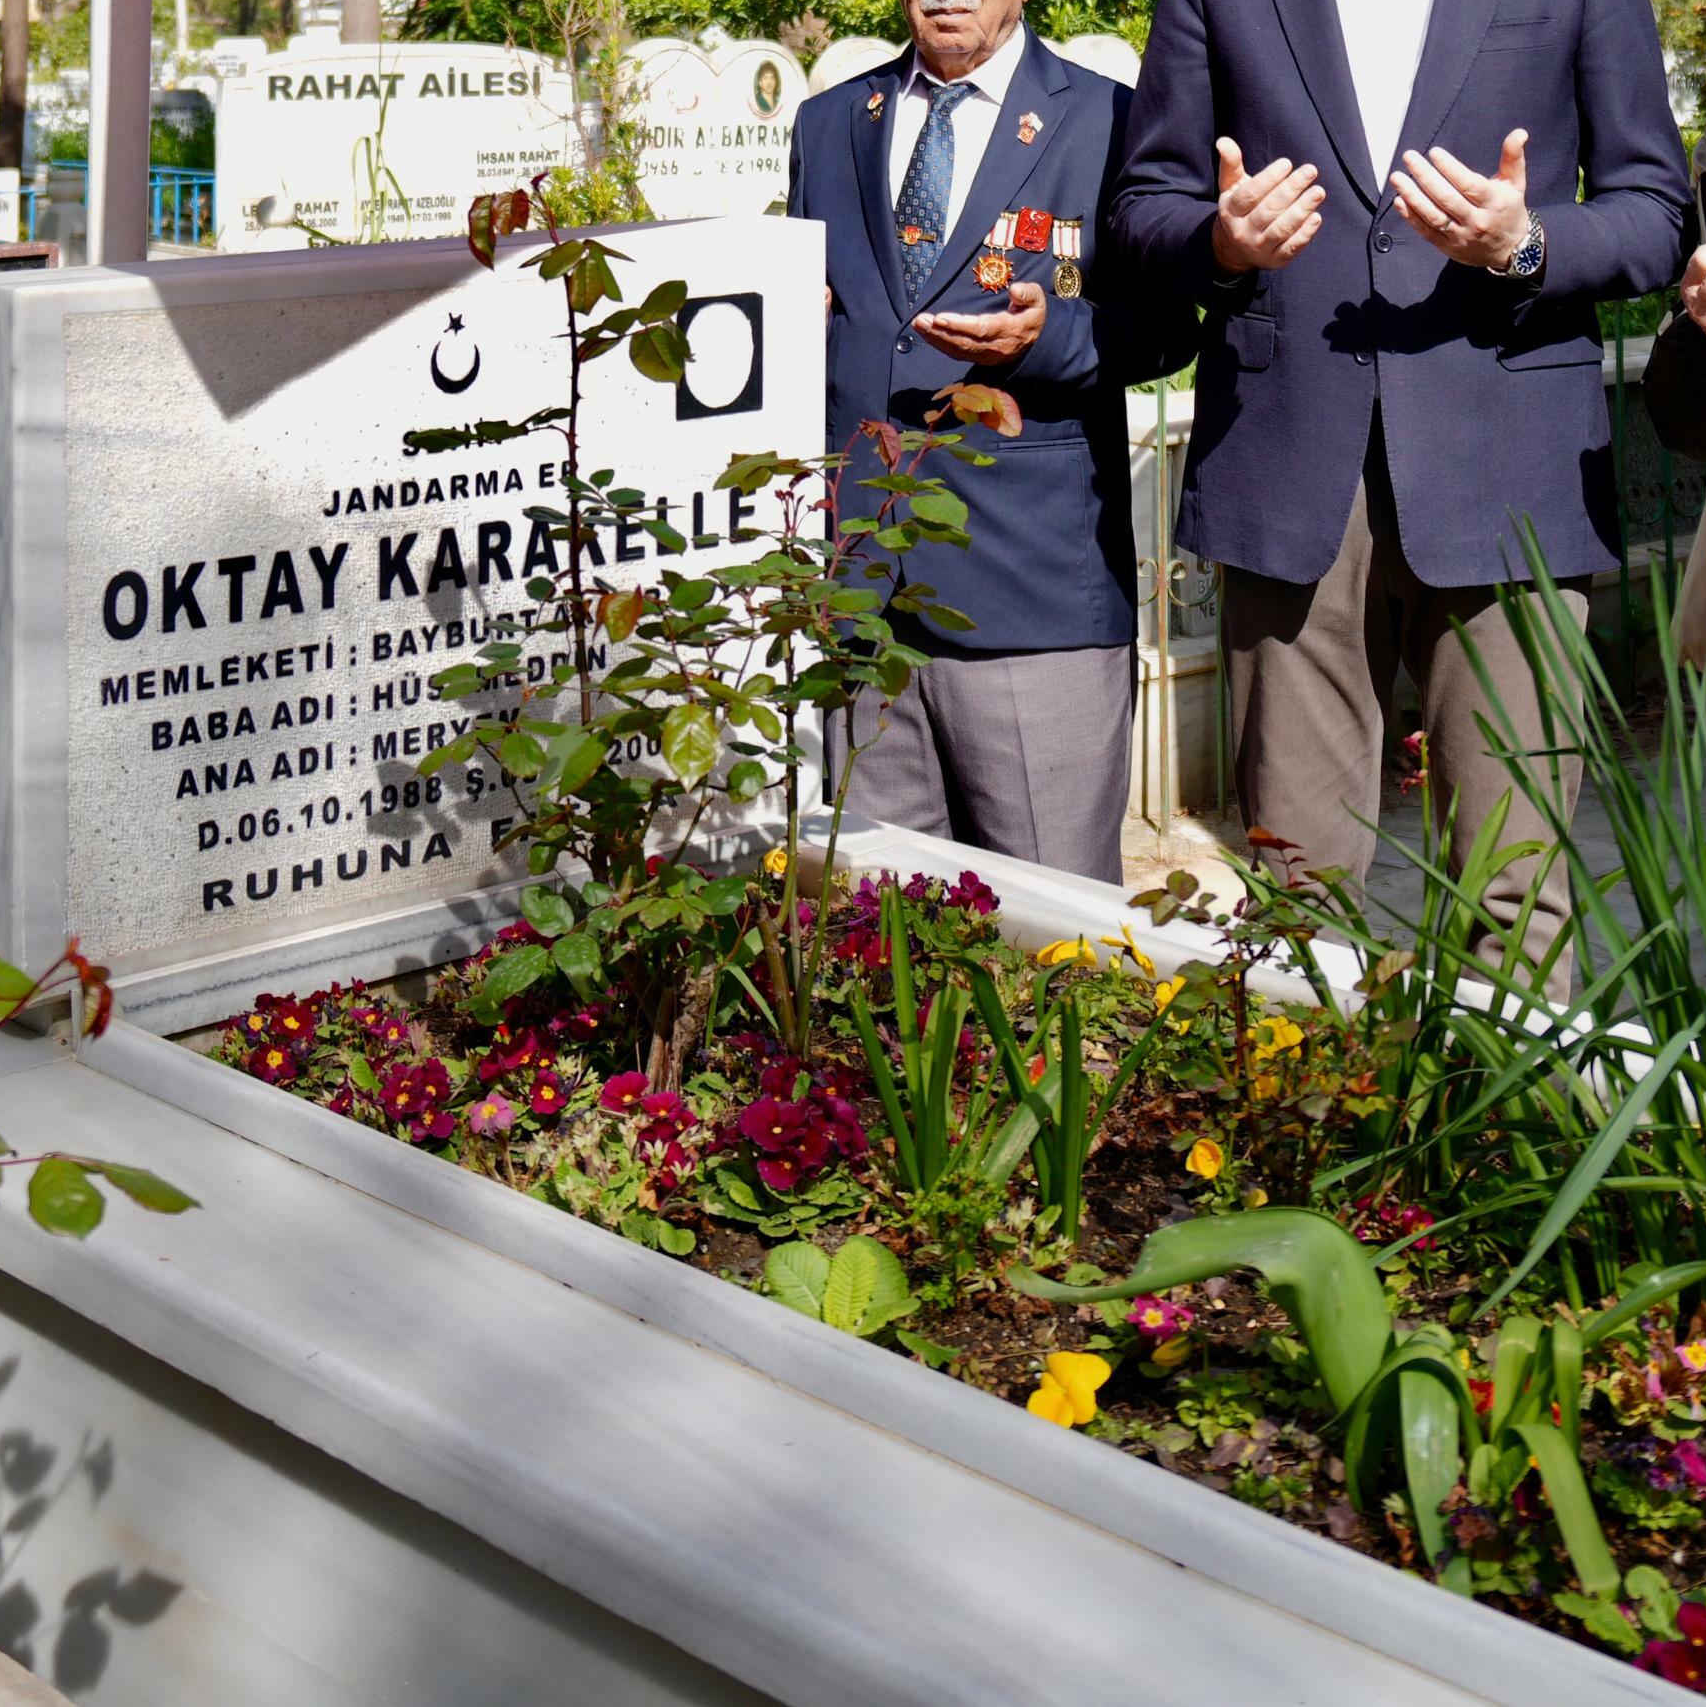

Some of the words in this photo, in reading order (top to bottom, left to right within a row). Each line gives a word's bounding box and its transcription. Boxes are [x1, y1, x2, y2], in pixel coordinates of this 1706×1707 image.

[267, 72, 405, 101] RAHAT
[418, 66, 542, 98] AİLESİ
[477, 150, 515, 164] İHSAN
[519, 150, 560, 163] RAHAT
[294, 201, 340, 215] RAHAT
[387, 197, 414, 210] RAT
[323, 468, 524, 517] JANDARMA
[103, 542, 349, 641] OKTAY
[100, 634, 334, 706] MEMLEKETİ
[373, 609, 538, 662] BAYBURT
[151, 706, 257, 751] BABA
[271, 693, 333, 730] ADI
[175, 758, 256, 799] ANA
[270, 741, 333, 780] ADI
[198, 776, 442, 852] D.06.10.1988
[202, 832, 453, 912] RUHUNA
